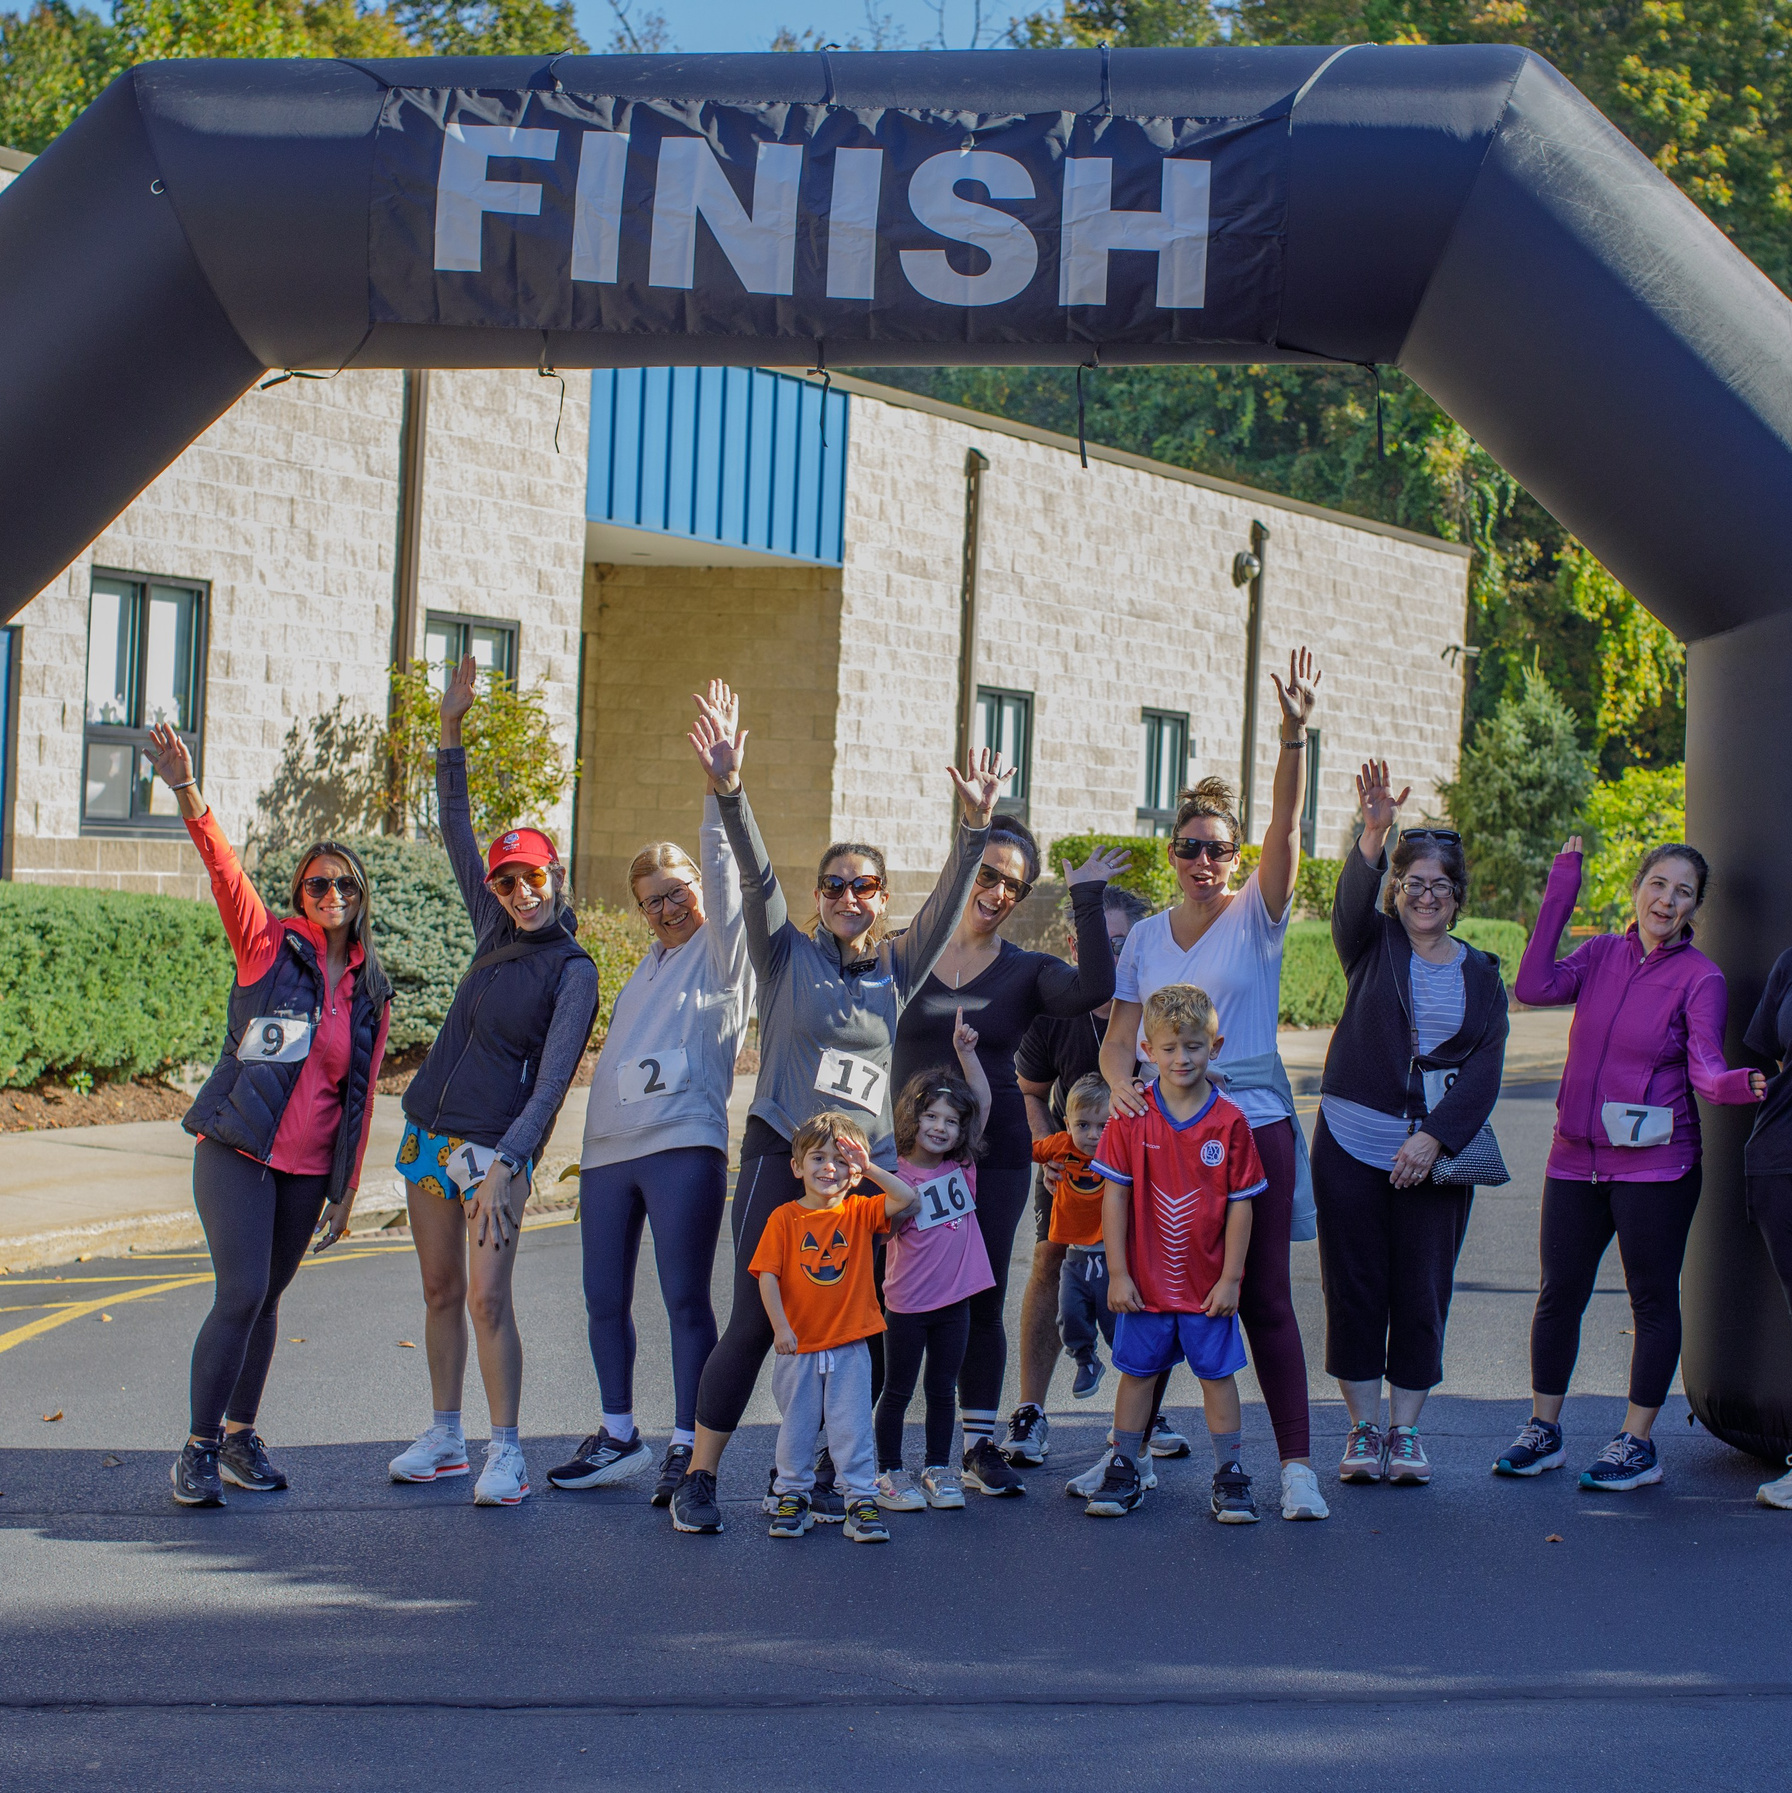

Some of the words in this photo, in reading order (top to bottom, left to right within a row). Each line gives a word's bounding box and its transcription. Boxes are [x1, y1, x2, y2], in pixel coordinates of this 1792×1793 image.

[433, 122, 1212, 309] FINISH
[261, 1023, 284, 1056] 9
[639, 1059, 666, 1094] 2
[831, 1059, 880, 1101] 17
[1626, 1109, 1648, 1141] 7
[461, 1147, 485, 1181] 1
[923, 1177, 966, 1221] 16
